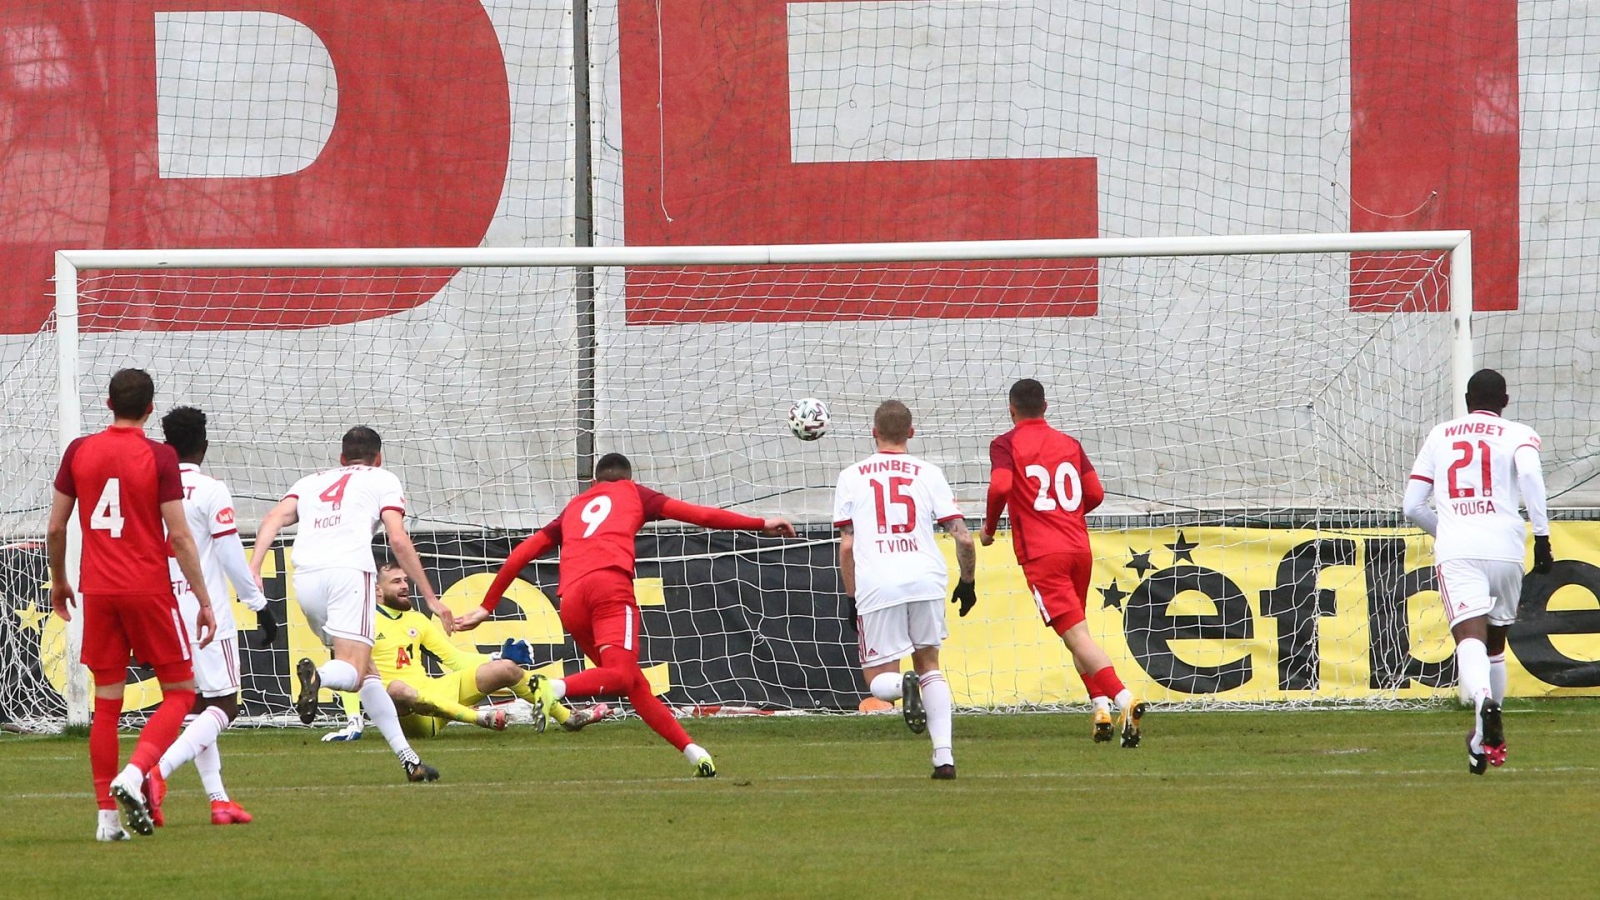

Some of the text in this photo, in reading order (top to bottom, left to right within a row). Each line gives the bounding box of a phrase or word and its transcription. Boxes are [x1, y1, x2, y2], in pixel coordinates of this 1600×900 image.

[1445, 423, 1505, 437] WINBET
[858, 459, 922, 476] WINBET
[1447, 440, 1493, 499] 21
[319, 473, 353, 511] 4
[869, 476, 916, 534] 15
[1025, 462, 1083, 512] 20
[90, 478, 125, 538] 4
[314, 514, 341, 529] KOCH
[580, 495, 612, 538] 9
[1452, 500, 1496, 516] YOUGA
[396, 643, 411, 669] A1
